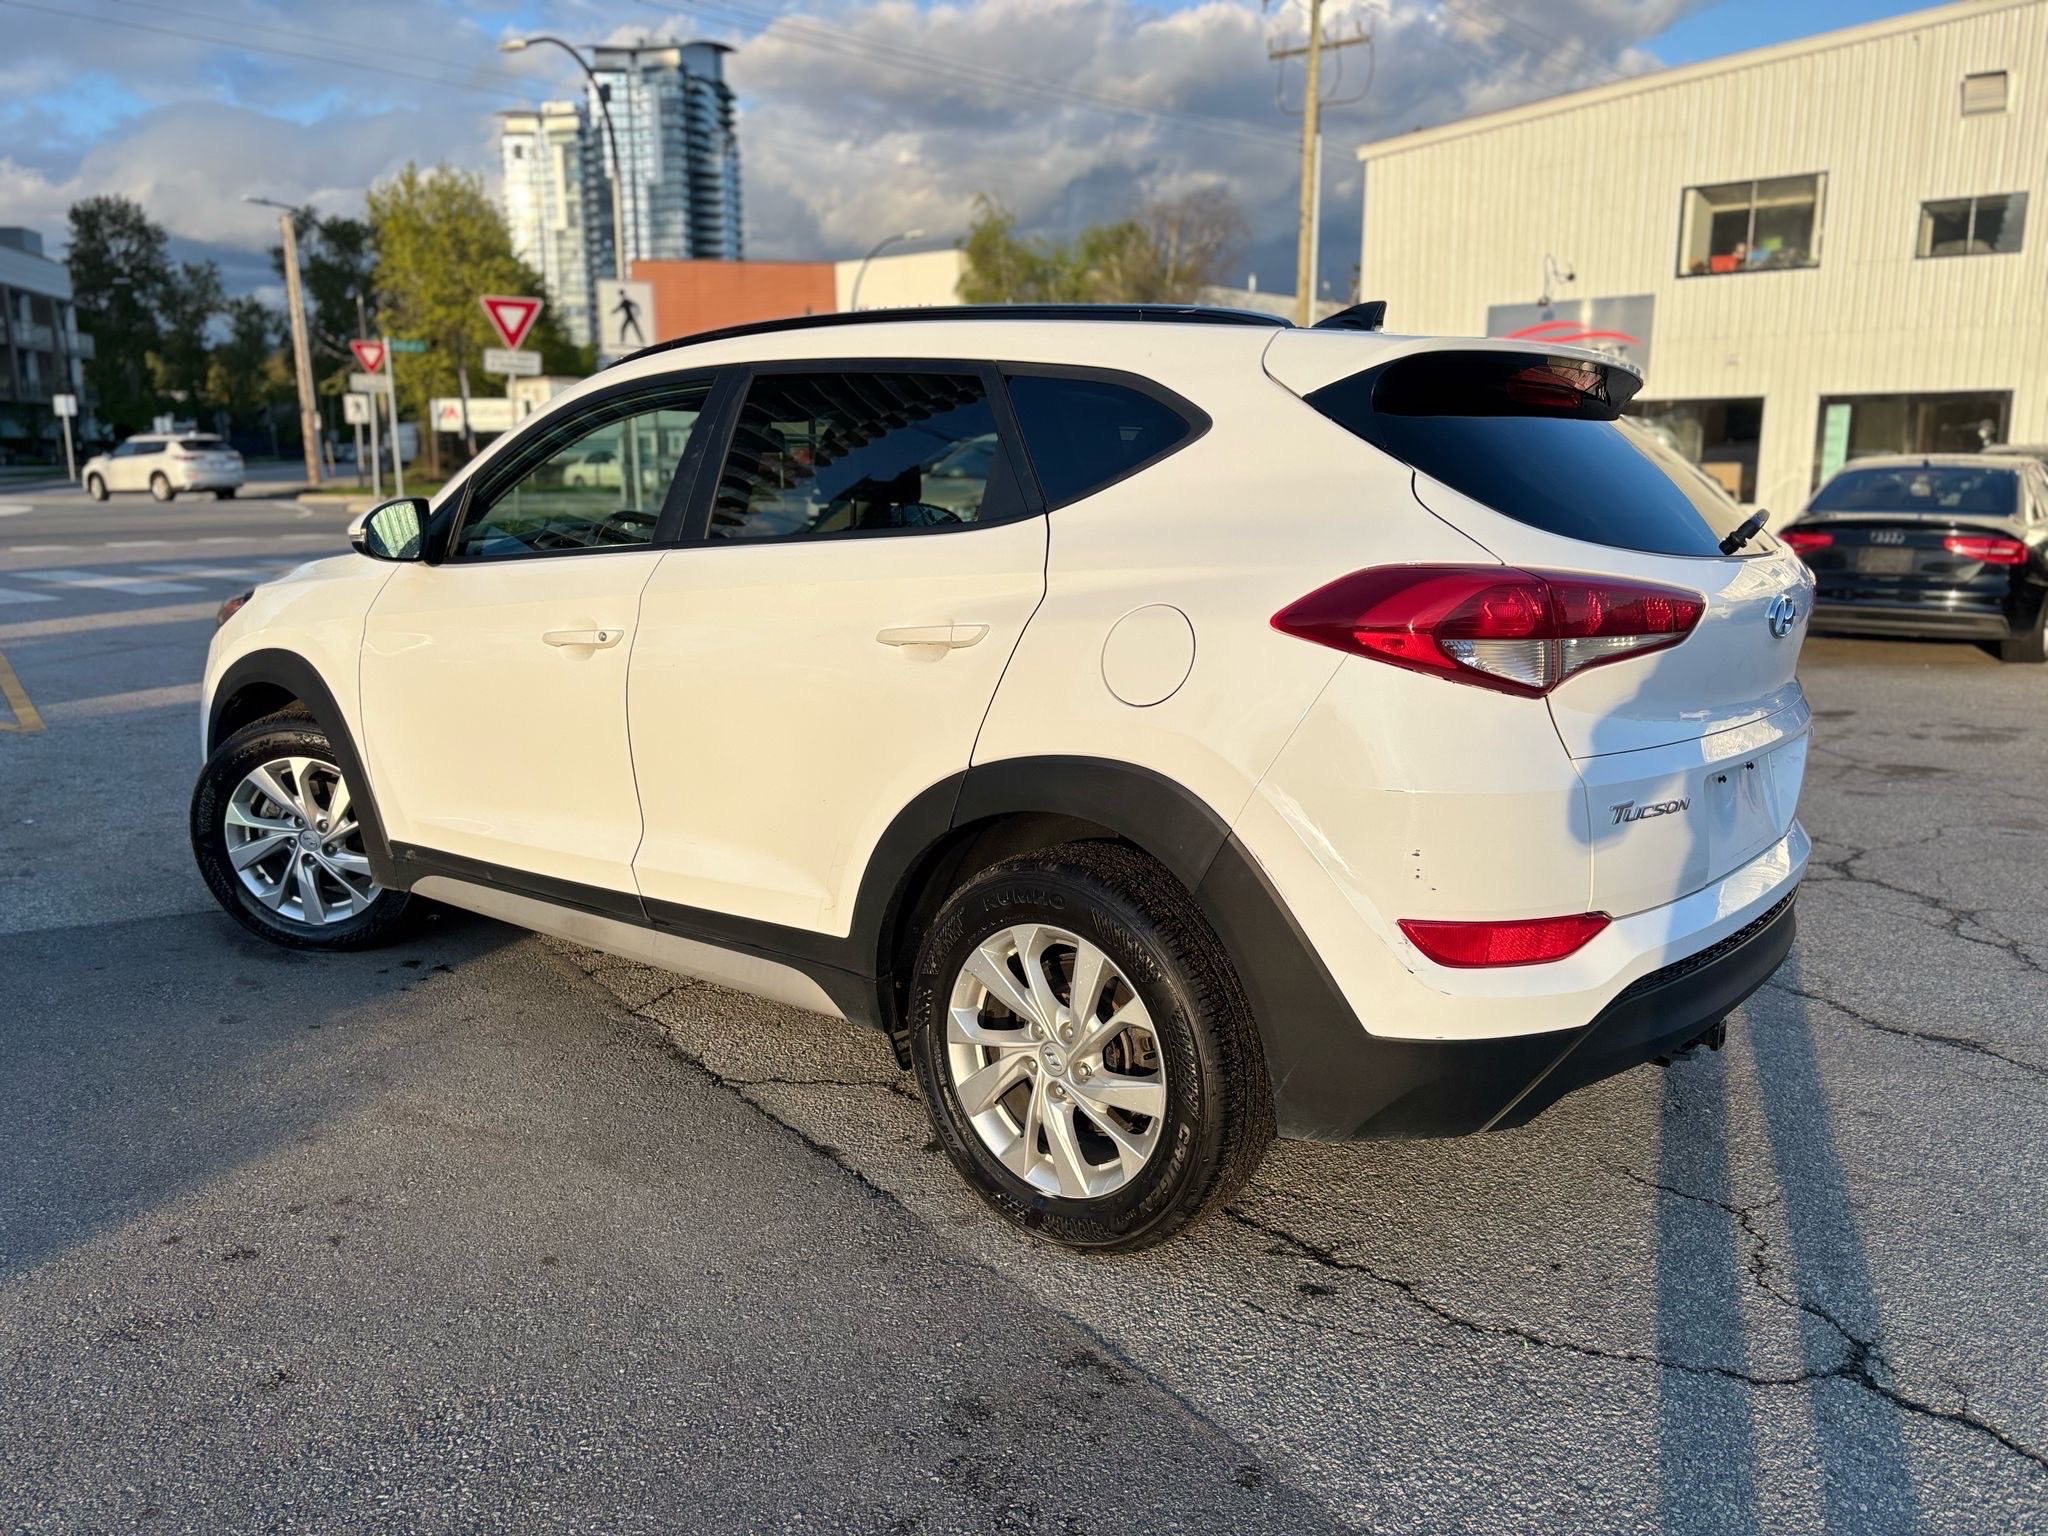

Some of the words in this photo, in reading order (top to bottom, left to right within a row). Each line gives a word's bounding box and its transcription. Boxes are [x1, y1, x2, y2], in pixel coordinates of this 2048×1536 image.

[1609, 797, 1691, 825] TUCSON
[982, 888, 1067, 912] KUMHO
[1139, 1121, 1191, 1218] CRUGEN
